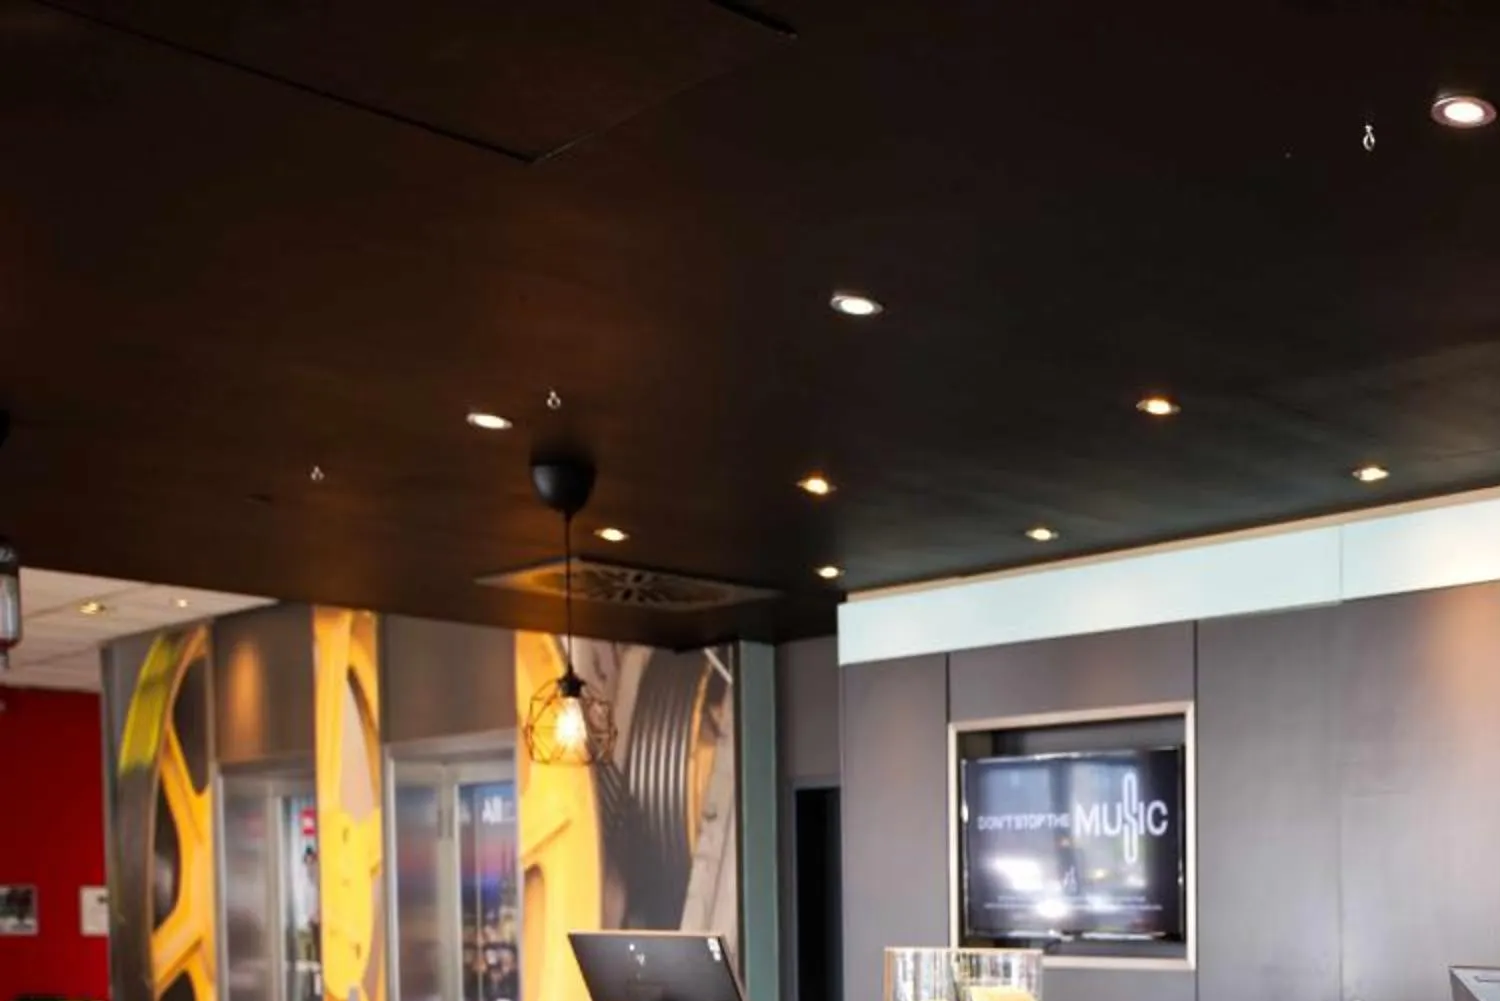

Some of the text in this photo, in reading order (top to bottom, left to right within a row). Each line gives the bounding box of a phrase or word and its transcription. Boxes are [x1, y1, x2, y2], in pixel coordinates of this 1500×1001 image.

[1013, 813, 1046, 830] STOP
[1047, 812, 1071, 828] THE
[1072, 771, 1169, 865] MUSIC
